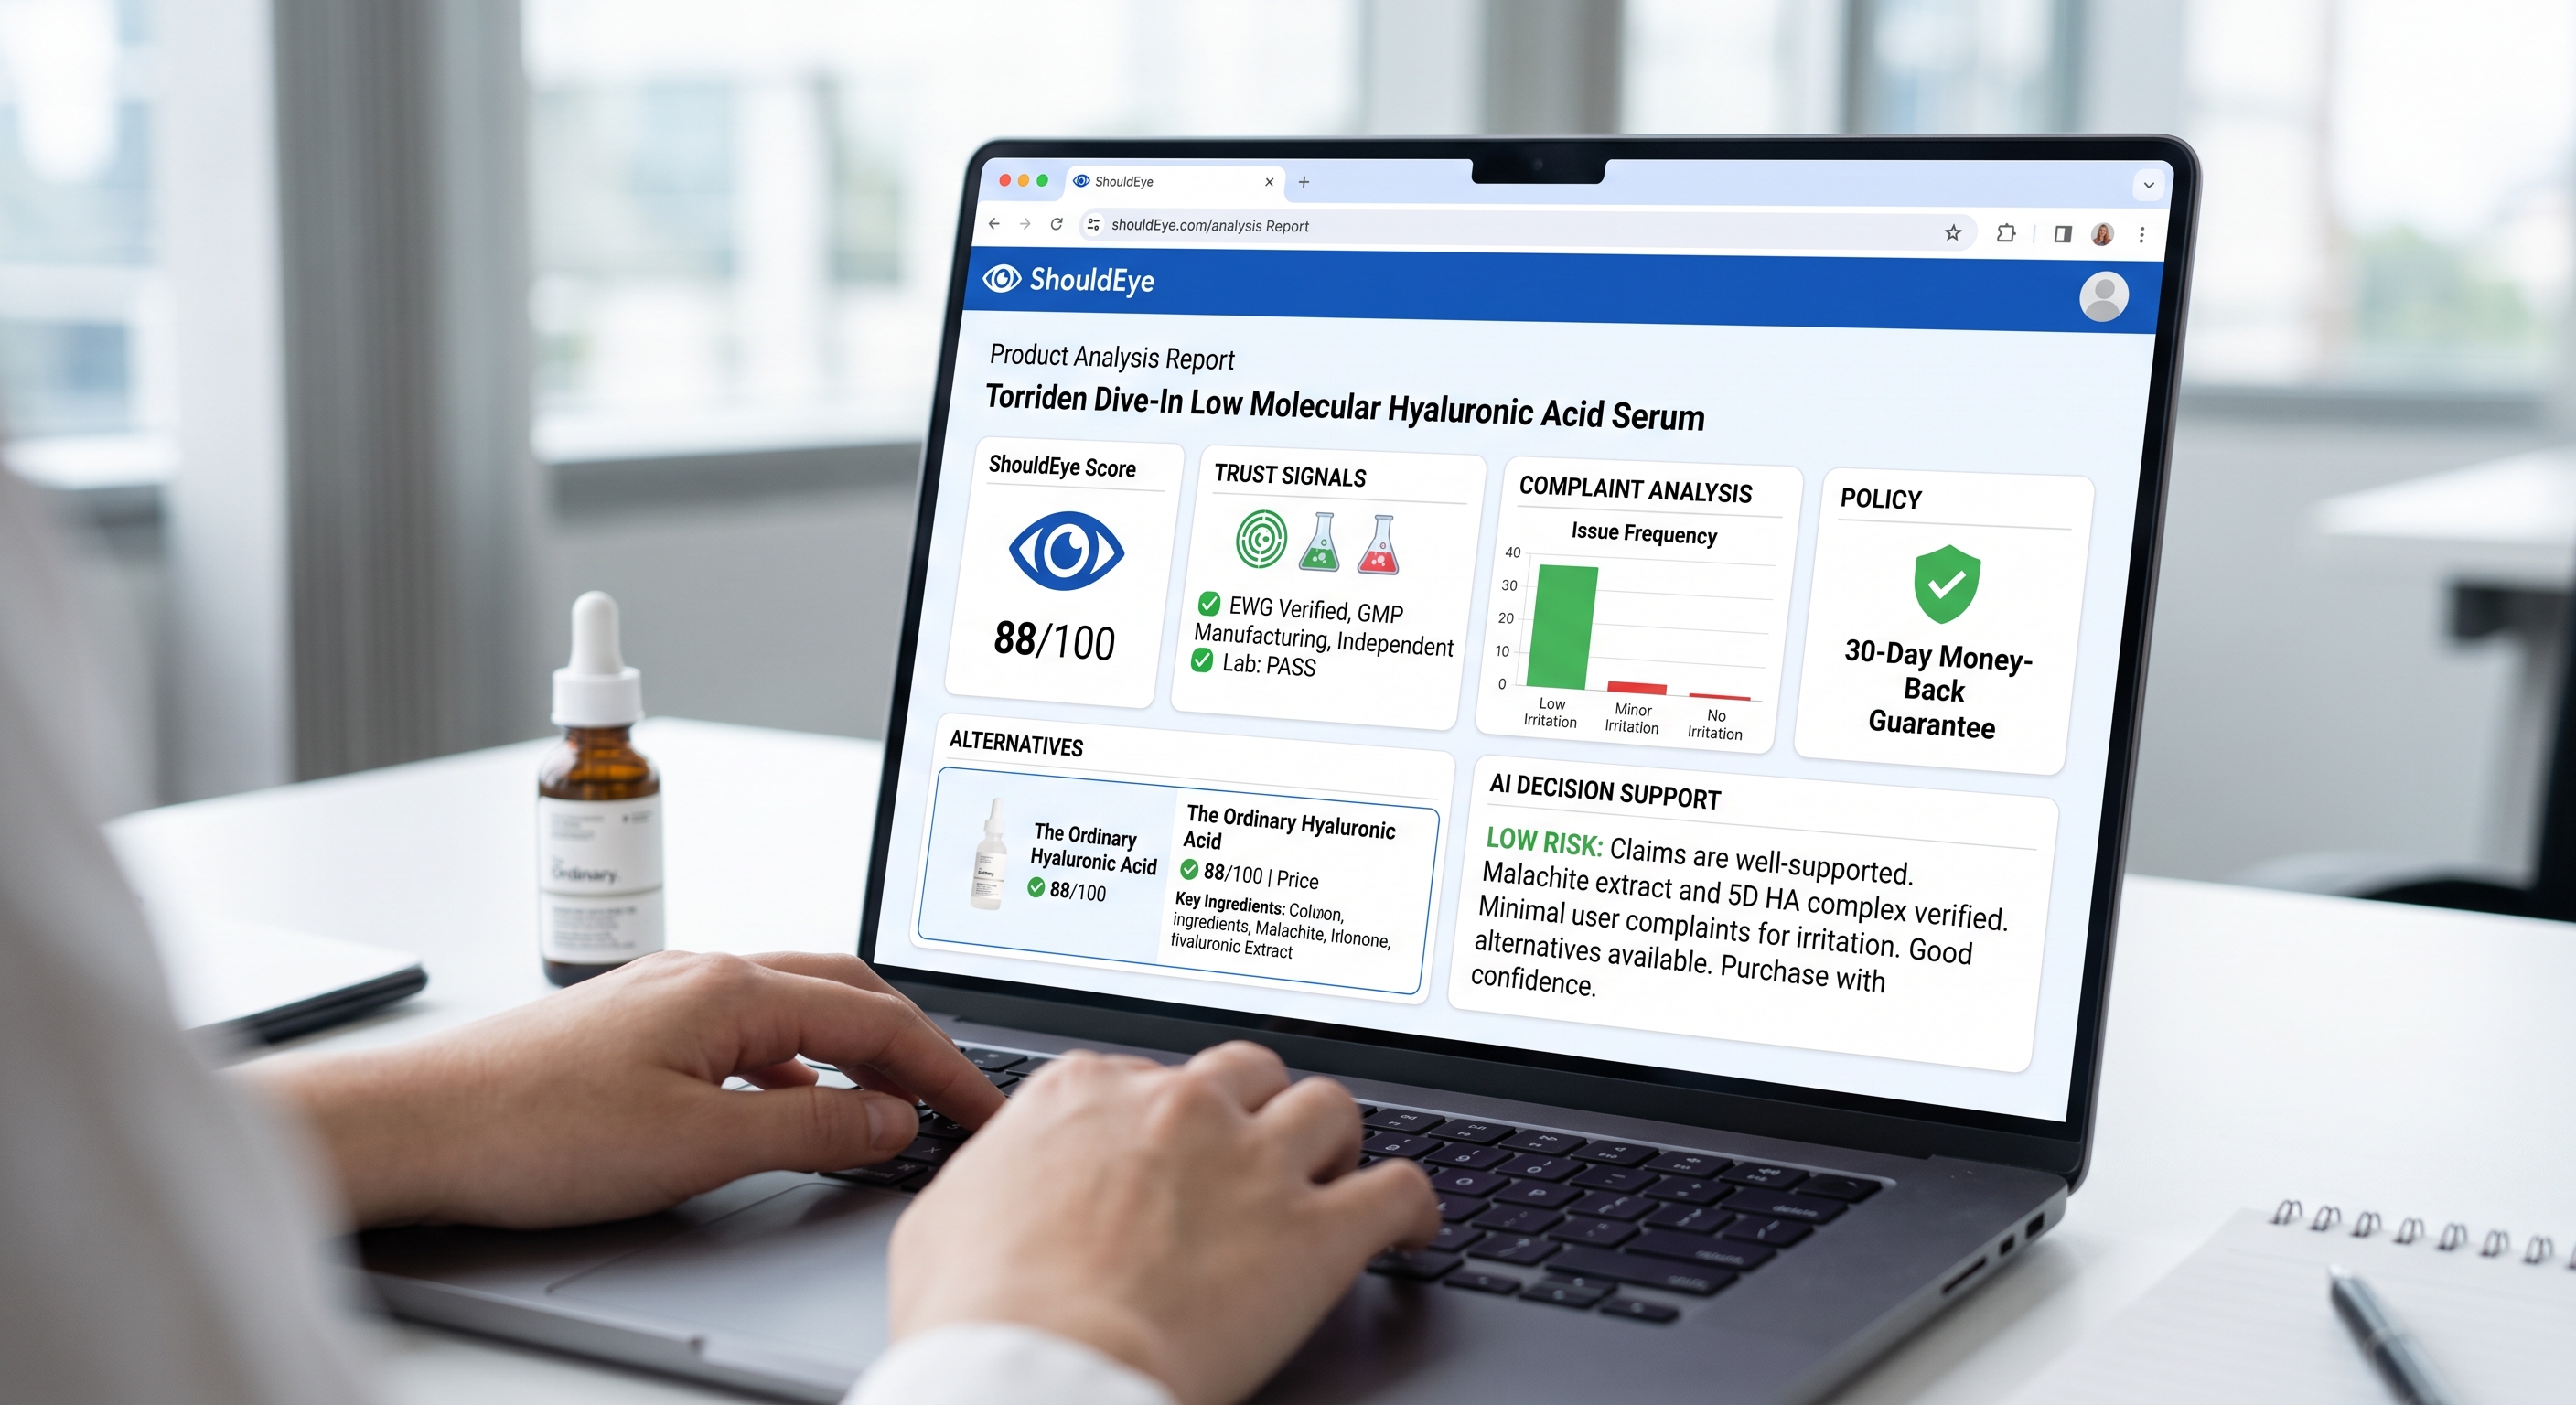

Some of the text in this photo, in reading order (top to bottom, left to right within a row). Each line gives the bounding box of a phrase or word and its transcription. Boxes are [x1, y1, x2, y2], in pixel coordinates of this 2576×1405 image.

[1095, 176, 1153, 189] ShouldEye
[1111, 218, 1309, 234] shouldEye.com/analysis Report
[1030, 266, 1154, 298] ShouldEye
[990, 342, 1235, 375] Product Analysis Report
[985, 382, 1704, 431] Torriden Dive-In Low Molecular Hyaluronic Acid Serum
[988, 454, 1136, 479] ShouldEye Score
[1215, 463, 1367, 488] TRUST SIGNALS
[1519, 475, 1753, 503] COMPLAINT ANALYSIS
[1841, 487, 1922, 509] POLICY
[1572, 520, 1718, 549] Issue Frequency
[1505, 546, 1520, 558] 40
[1501, 579, 1517, 591] 30
[1229, 595, 1403, 624] EWG Verified, GMP
[1497, 612, 1514, 624] 20
[993, 619, 1114, 660] 88/100
[1194, 622, 1454, 657] Manufacturing, Independent
[1496, 645, 1509, 657] 10
[1223, 652, 1316, 677] Lab: PASS
[1844, 638, 2033, 677] 30-Day Money-
[1498, 678, 1506, 690] 0
[1904, 676, 1965, 702] Back
[1539, 696, 1565, 710] Low
[1615, 702, 1652, 716] Minor
[1707, 708, 1726, 722] No
[1524, 713, 1576, 728] Irritation
[1605, 718, 1658, 735] Irritation
[1688, 724, 1742, 740] Irritation
[1869, 708, 1995, 739] Guarantee
[949, 729, 1083, 756] ALTERNATIVES
[1488, 772, 1722, 810] AI DECISION SUPPORT
[1186, 803, 1396, 840] The Ordinary Hyaluronic
[1034, 821, 1137, 852] The Ordinary
[1182, 830, 1222, 850] Acid
[1030, 847, 1157, 875] Hyaluronic Acid
[1487, 826, 1912, 885] LOW RISK: Claims are well-supported.
[1204, 862, 1262, 884] 88/100
[1276, 869, 1318, 889] Price
[1049, 880, 1106, 902] 88/100
[1175, 890, 1201, 909] Key
[1204, 893, 1285, 916] Ingredients:
[1483, 860, 2007, 931] Malachite extract and 5D HA complex verified.
[1173, 911, 1250, 936] ingredients,
[1255, 919, 1326, 943] Malachite,
[1478, 894, 1972, 965] Minimal user complaints for irritation. Good
[1244, 939, 1293, 959] Extract
[1475, 928, 1884, 992] alternatives available. Purchase with
[1471, 966, 1595, 997] confidence.
